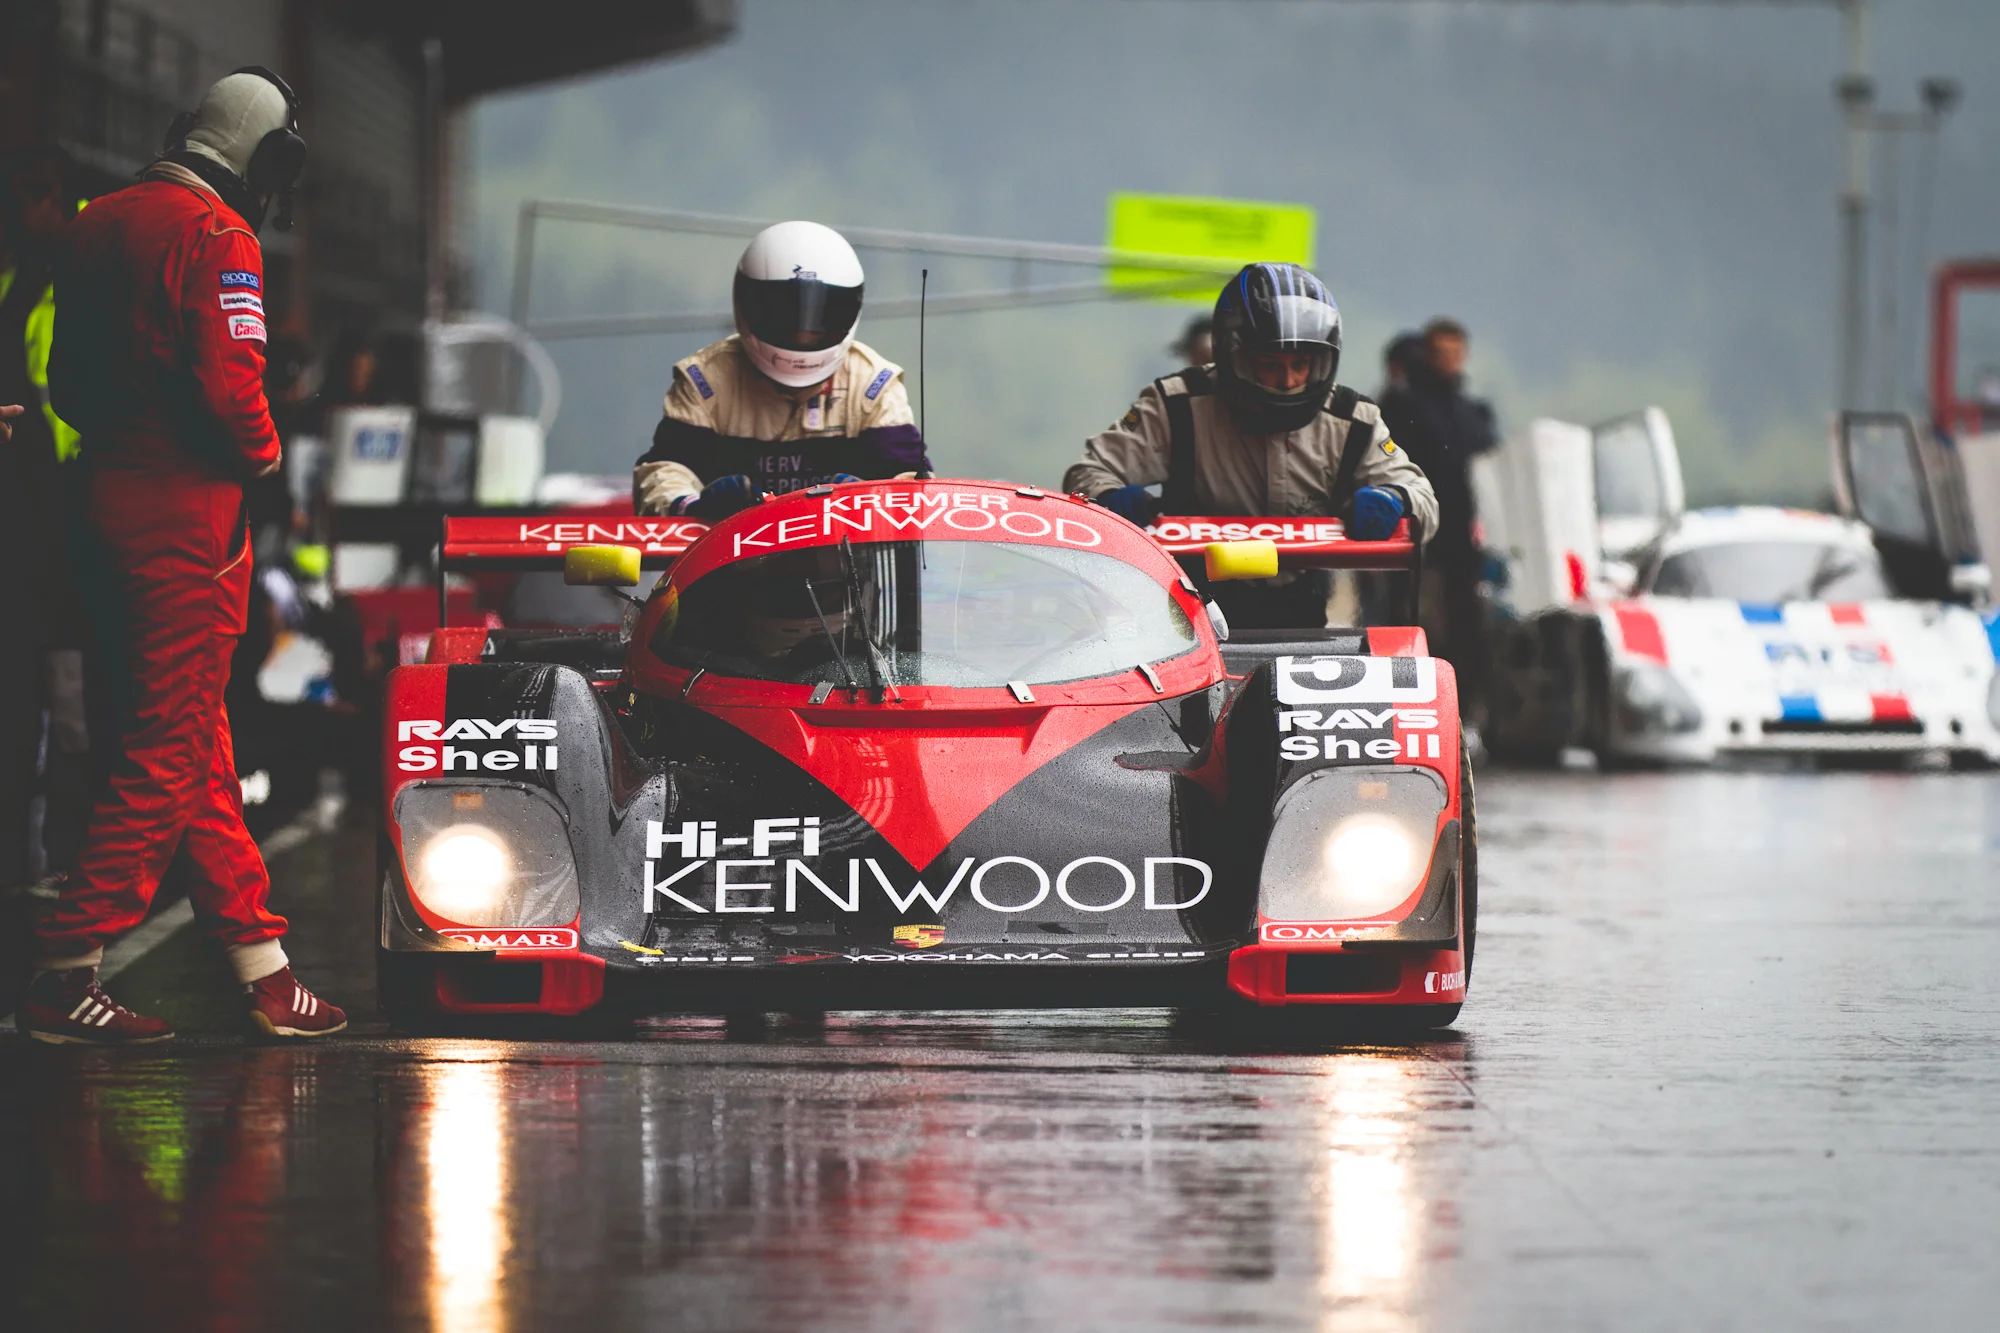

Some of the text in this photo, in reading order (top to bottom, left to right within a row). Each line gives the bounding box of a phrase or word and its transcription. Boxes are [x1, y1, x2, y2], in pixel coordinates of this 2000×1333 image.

[222, 273, 259, 285] sparco
[823, 492, 1008, 512] KREMER
[734, 507, 1102, 557] KENWOOD
[1144, 523, 1346, 541] ORSCHE
[397, 718, 559, 742] RAYS
[1279, 708, 1439, 732] RAYS
[397, 745, 558, 771] Shell
[1280, 734, 1440, 761] Shell
[646, 816, 820, 858] Hi-Fi
[643, 856, 1213, 914] KENWOOD
[843, 953, 1069, 963] YOKOHAMA
